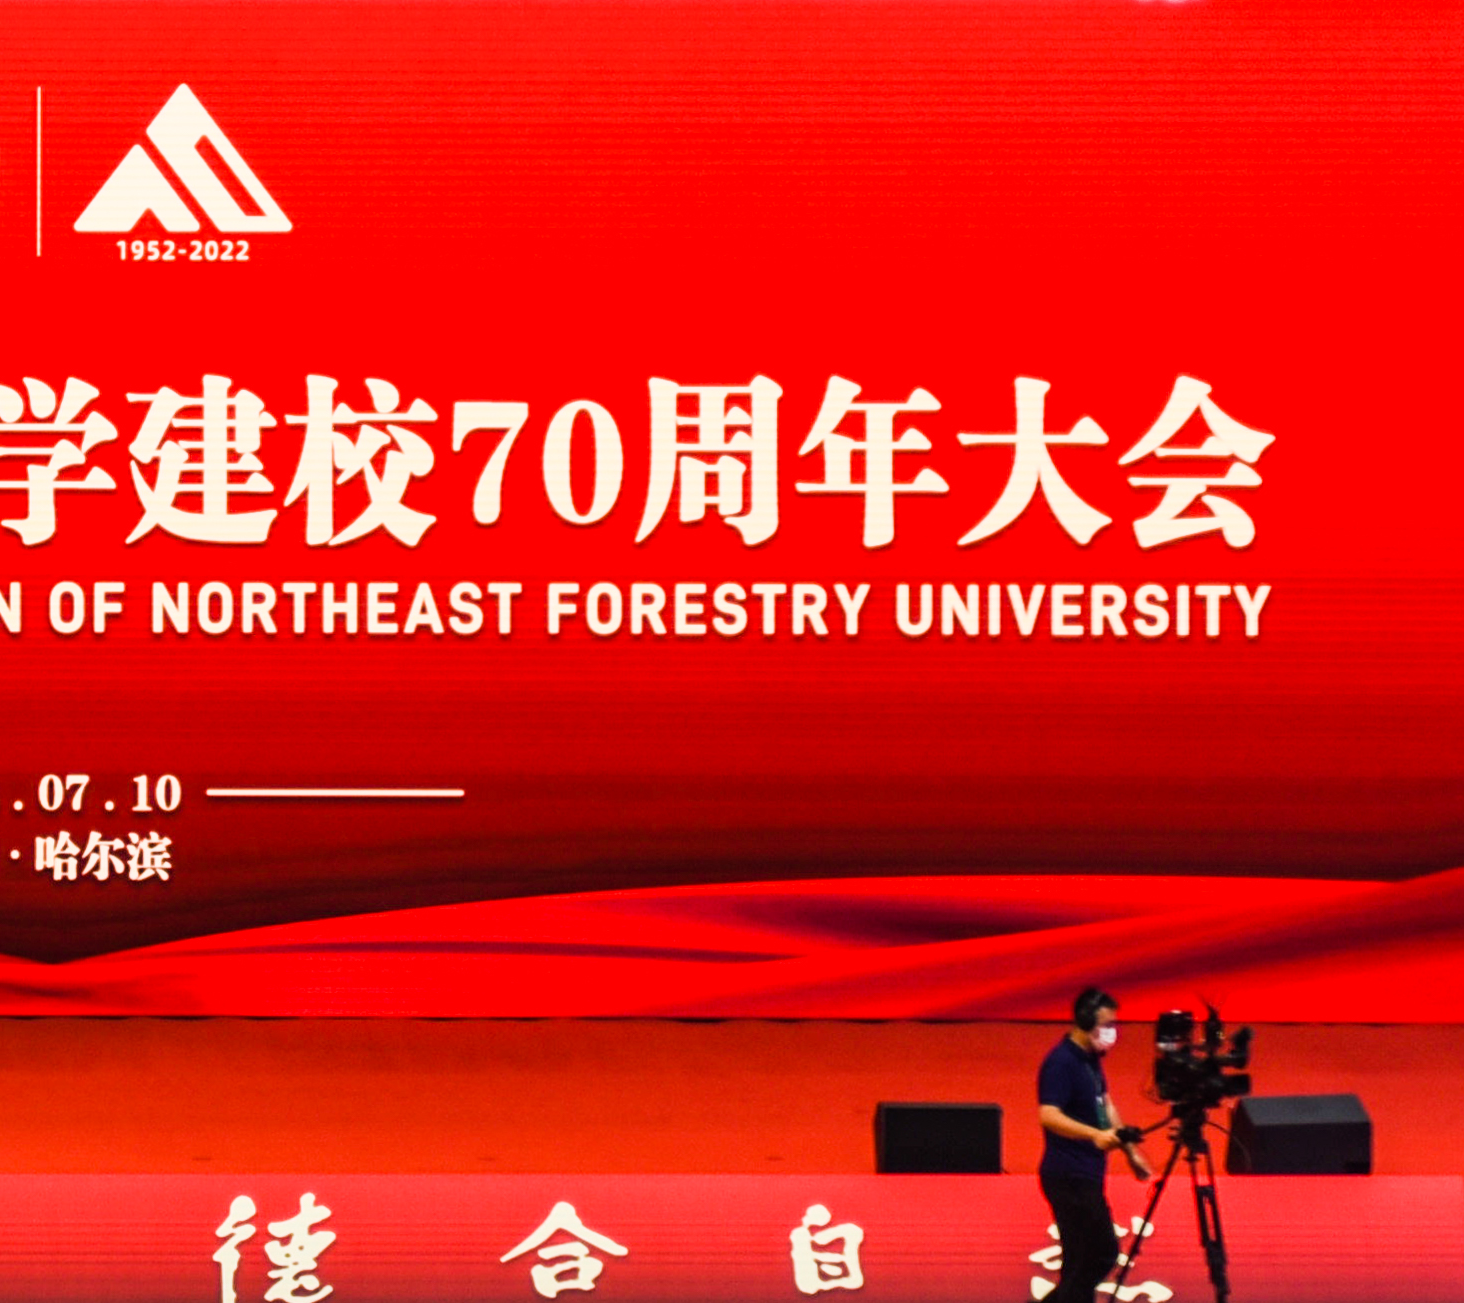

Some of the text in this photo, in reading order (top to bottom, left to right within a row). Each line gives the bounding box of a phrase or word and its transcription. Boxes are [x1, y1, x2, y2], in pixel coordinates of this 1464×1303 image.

[116, 240, 250, 261] 1952-2022
[49, 581, 125, 635] OF
[152, 581, 522, 635] NORTHEAST
[548, 582, 871, 636] FORESTRY
[896, 584, 1271, 638] UNIVERSITY
